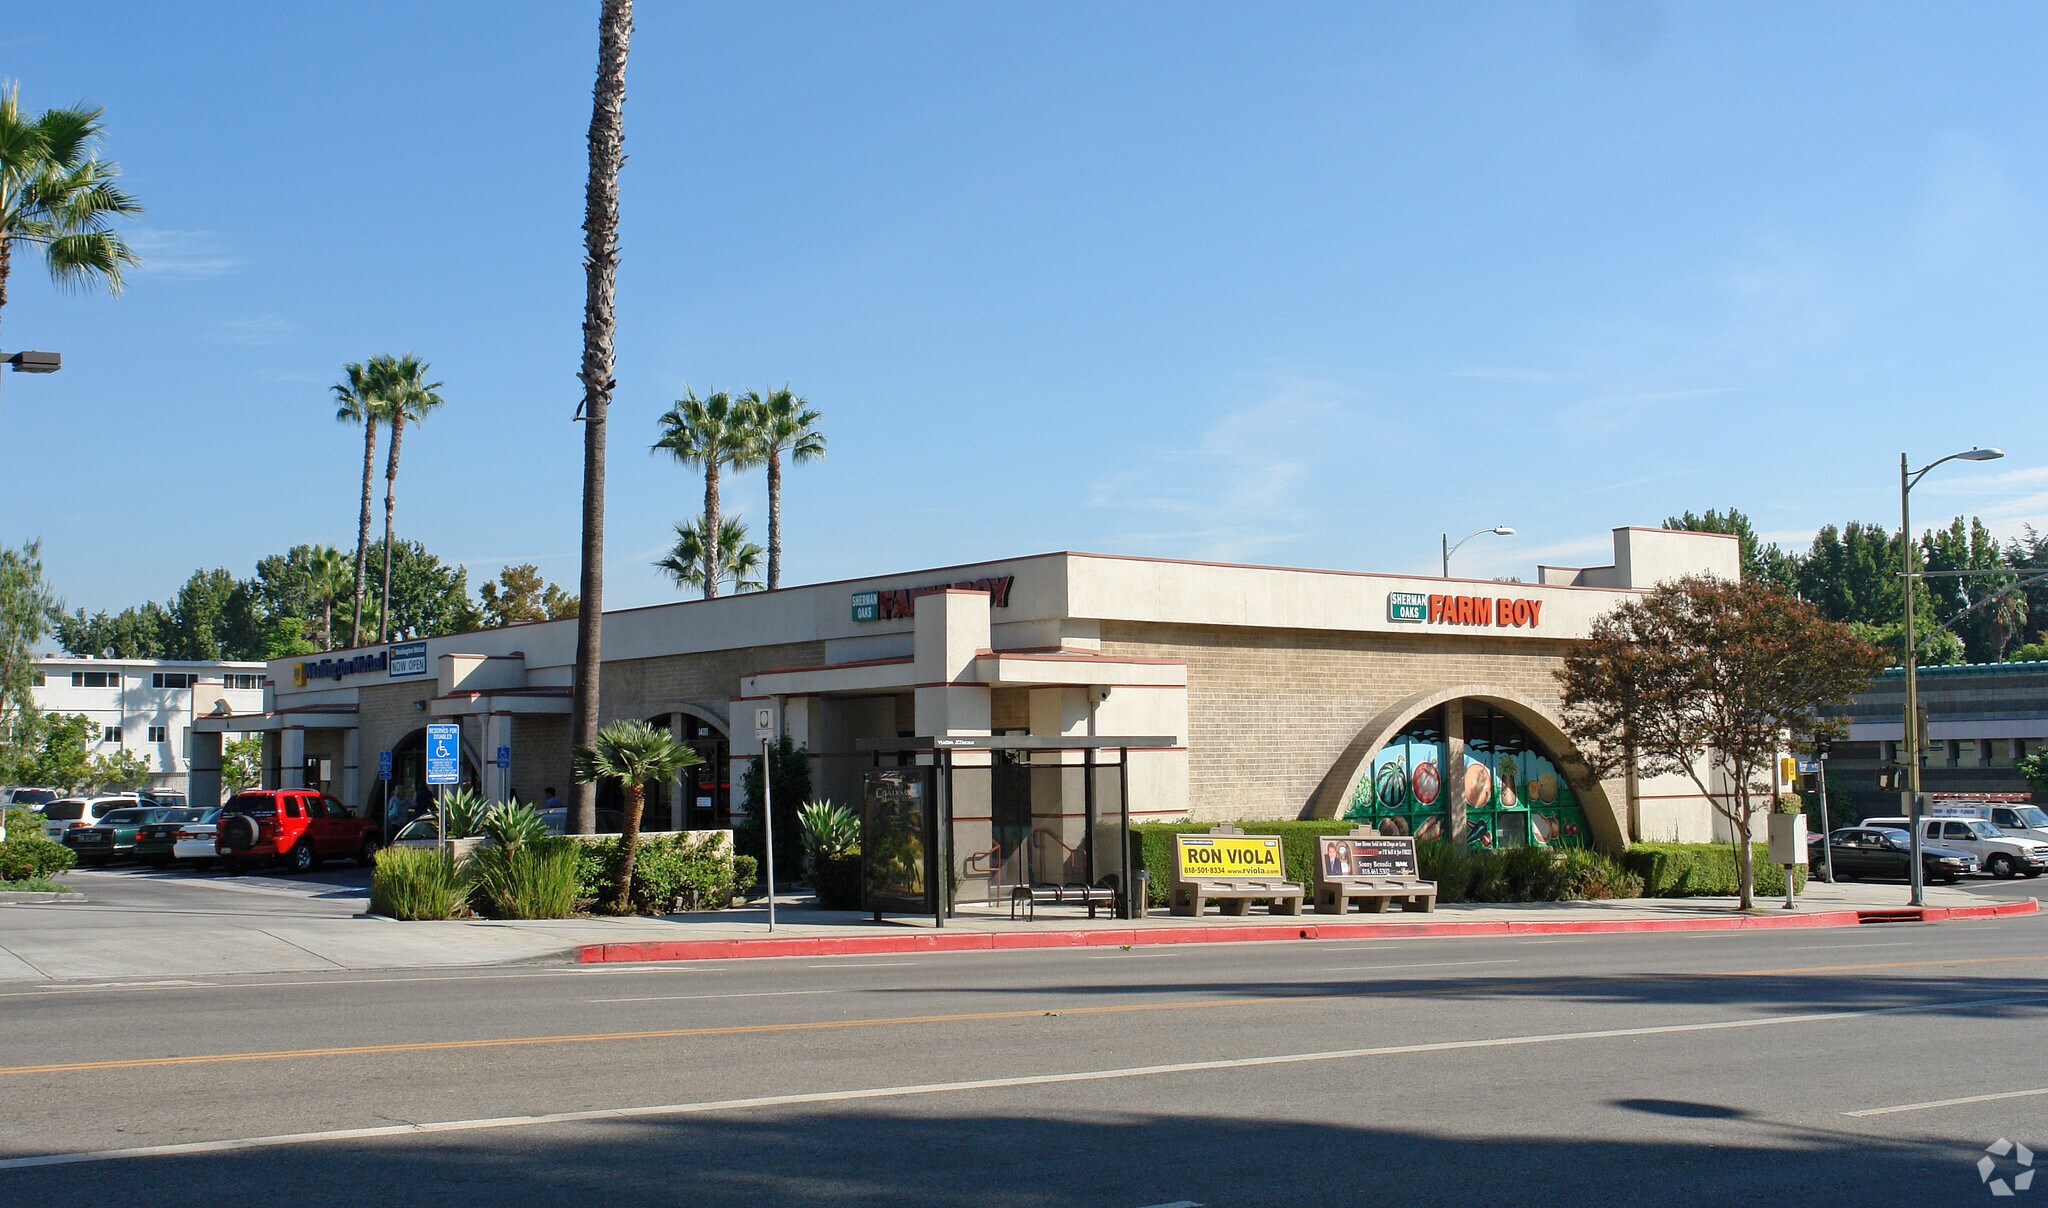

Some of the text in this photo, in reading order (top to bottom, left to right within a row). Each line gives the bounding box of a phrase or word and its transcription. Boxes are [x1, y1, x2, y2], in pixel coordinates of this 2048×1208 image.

[852, 593, 878, 607] SHERMAN
[1392, 592, 1427, 606] SHERMAN
[857, 607, 872, 619] OAKS
[1400, 606, 1420, 619] OAKS
[1428, 594, 1542, 628] FARM BOY
[304, 651, 387, 681] Washington Mutual
[392, 658, 424, 673] NOW OPEN
[1187, 848, 1276, 865] RON VIOLA
